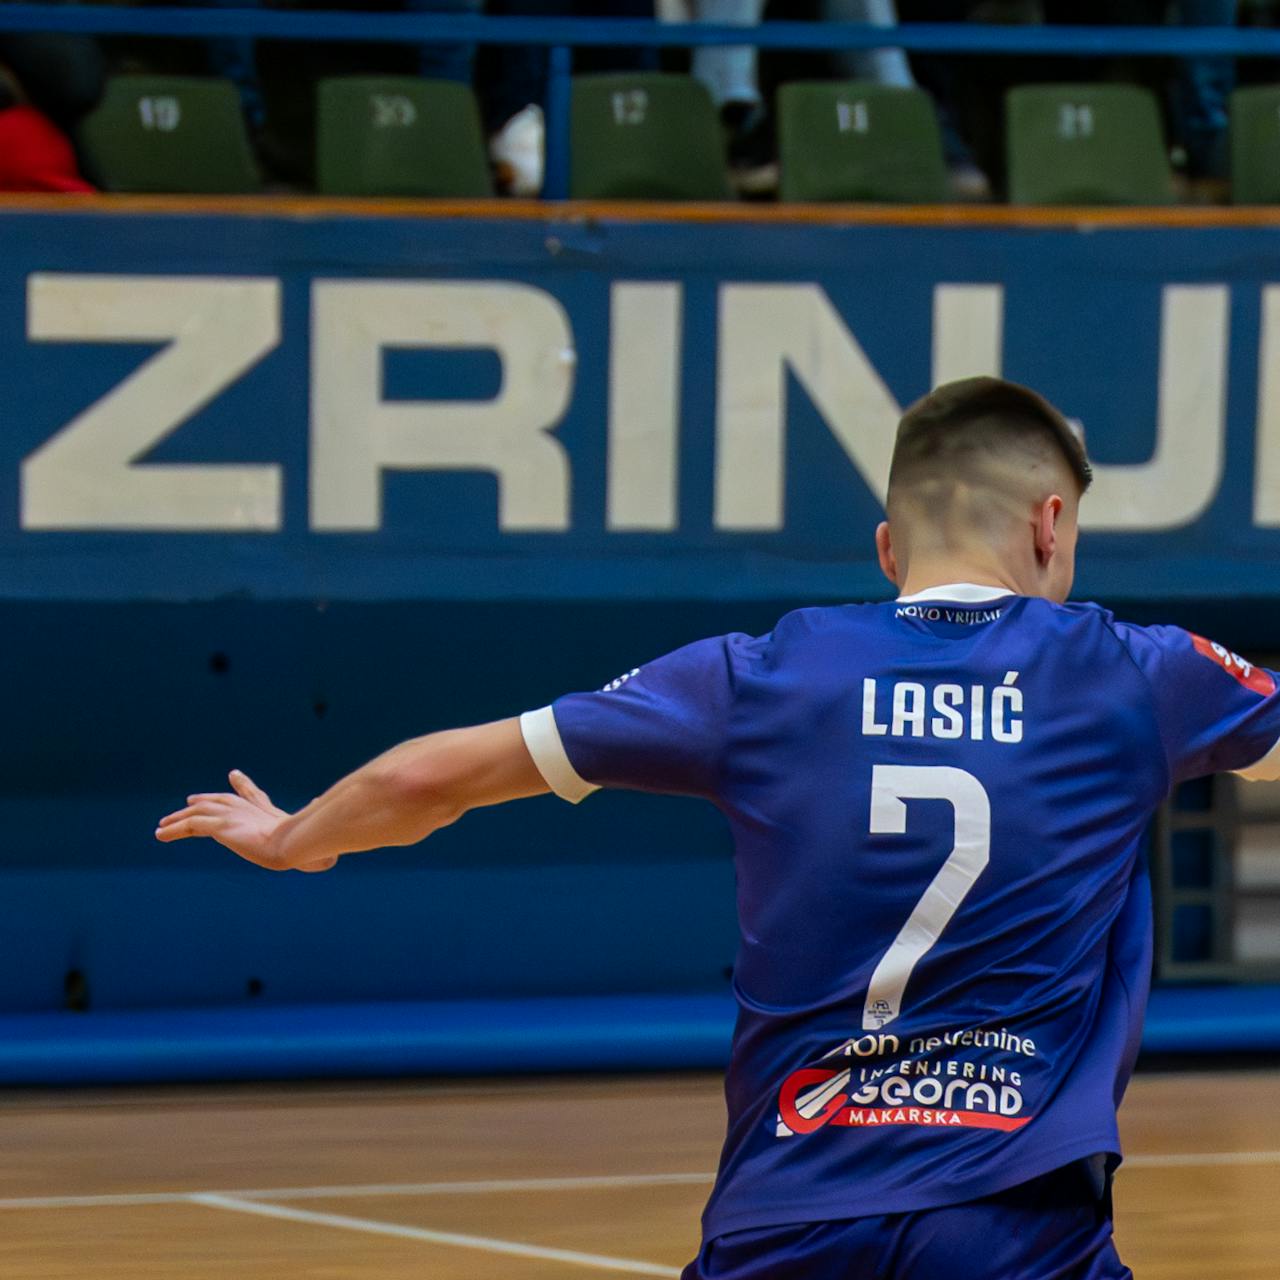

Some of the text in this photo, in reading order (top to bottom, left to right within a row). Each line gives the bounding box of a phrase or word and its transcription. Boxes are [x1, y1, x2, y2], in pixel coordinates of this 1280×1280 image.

[895, 606, 941, 621] NOVO
[861, 671, 1024, 744] LASIĆ
[862, 765, 991, 1031] 7
[860, 1060, 1021, 1086] INENJERING
[849, 1109, 962, 1125] MAKARSKA
